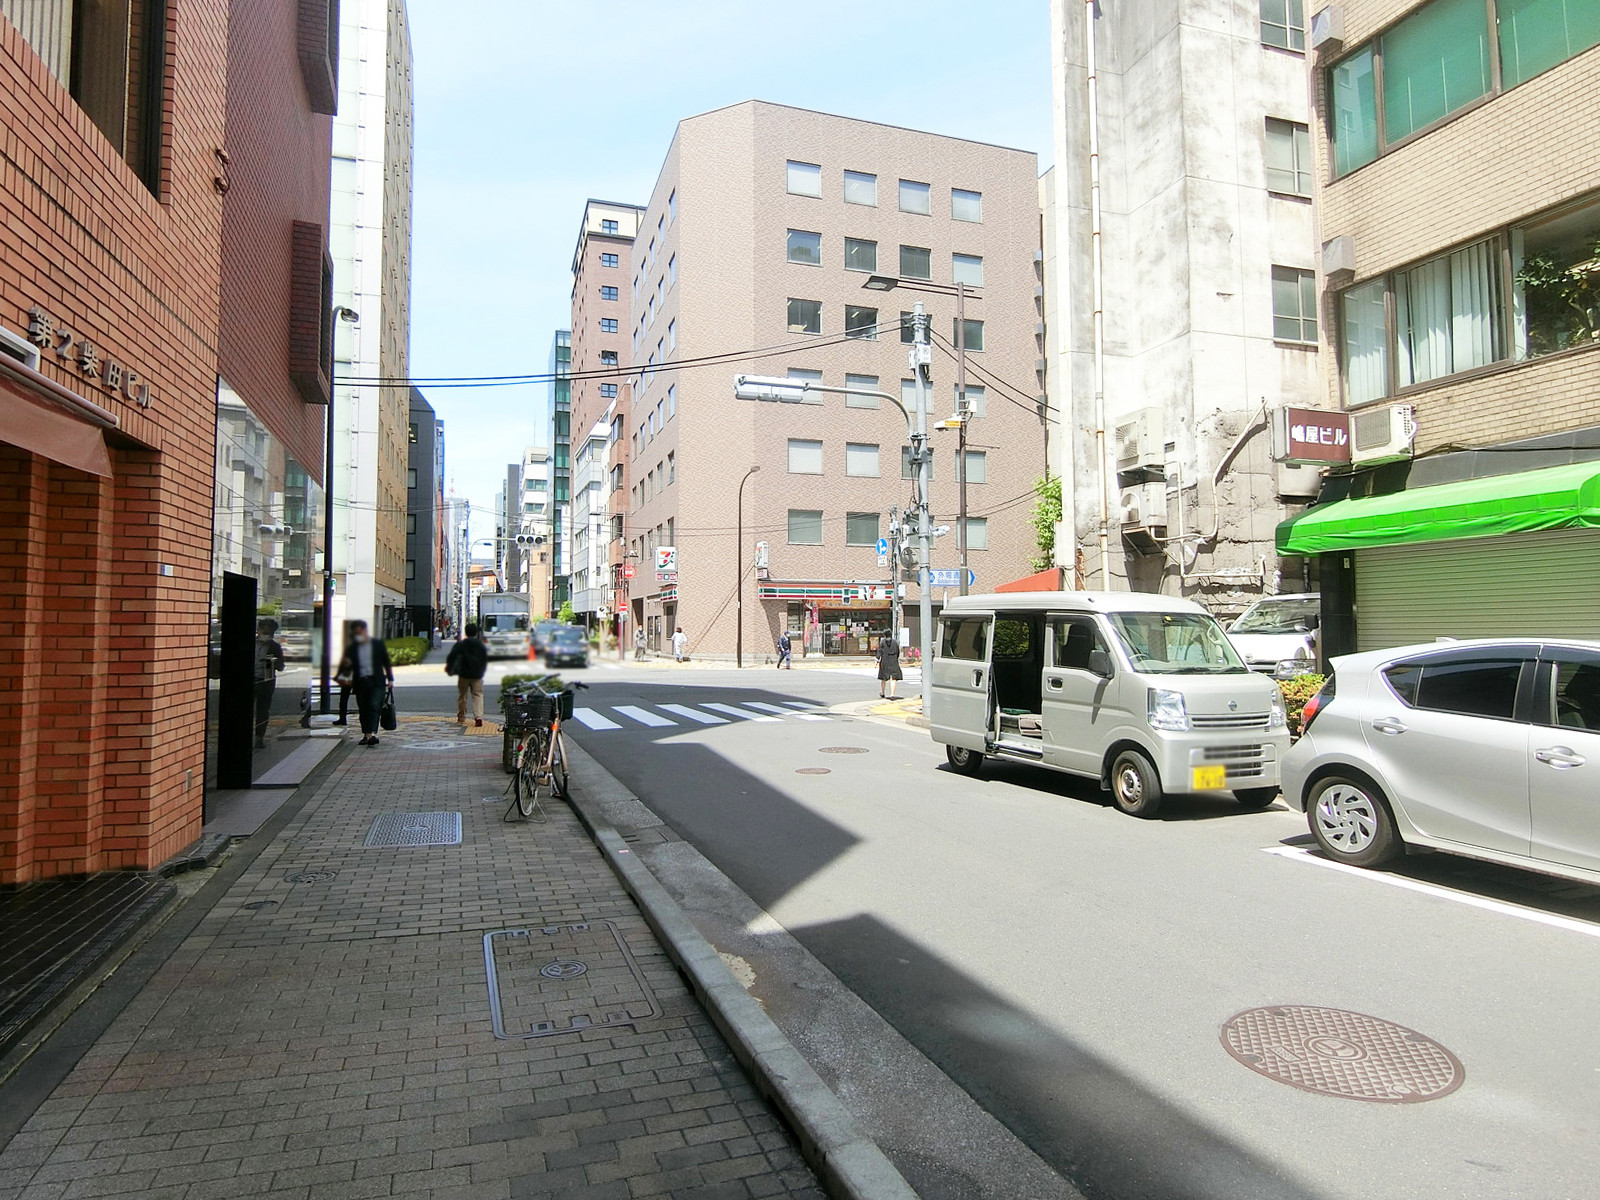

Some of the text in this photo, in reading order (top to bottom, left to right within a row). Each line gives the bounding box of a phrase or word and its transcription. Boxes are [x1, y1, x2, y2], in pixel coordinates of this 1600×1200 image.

[28, 306, 153, 409] 第2柴田ビル
